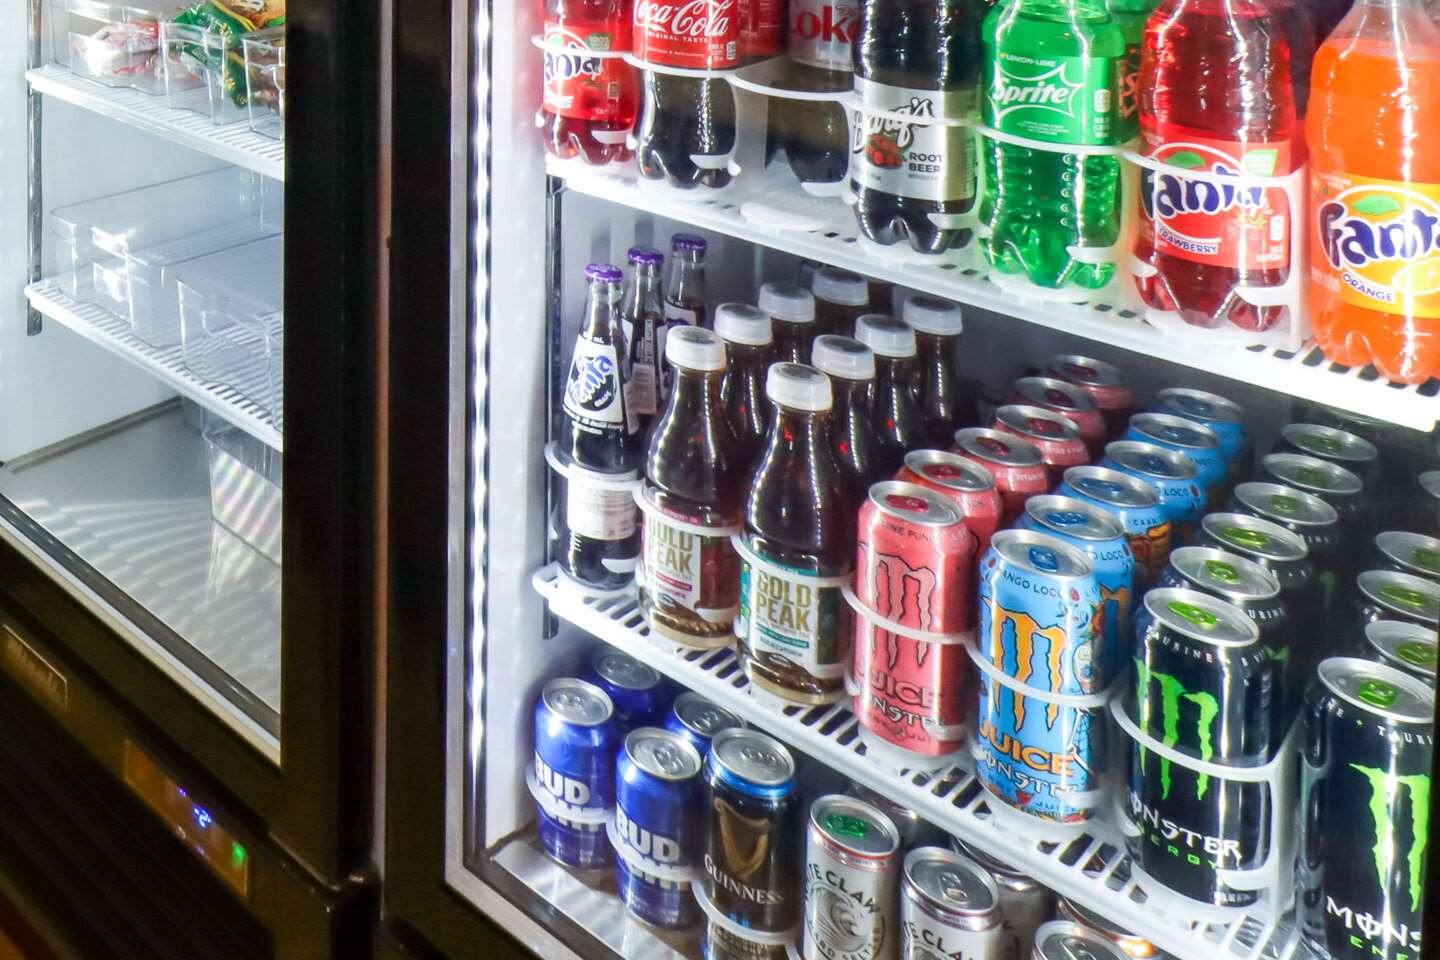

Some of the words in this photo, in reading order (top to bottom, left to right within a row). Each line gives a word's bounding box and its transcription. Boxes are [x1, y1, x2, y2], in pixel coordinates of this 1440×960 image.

[992, 76, 1070, 105] Sprite
[907, 161, 941, 173] BEER
[908, 152, 943, 163] ROOT
[1158, 226, 1218, 254] TRAWBERRY
[1318, 201, 1440, 268] Fant
[1342, 273, 1394, 302] ORANGE
[648, 539, 695, 576] PEAK
[1100, 551, 1124, 561] LOCO
[755, 569, 812, 609] GOLD
[1002, 570, 1030, 589] ANGO
[755, 591, 811, 633] PEAK
[1376, 724, 1433, 745] TAURI
[535, 750, 591, 806] BUD
[615, 801, 681, 863] BUD
[1130, 791, 1243, 869] ONSTER
[704, 853, 785, 905] GUINNESS
[824, 870, 881, 914] CLAW
[1326, 894, 1422, 953] MONS
